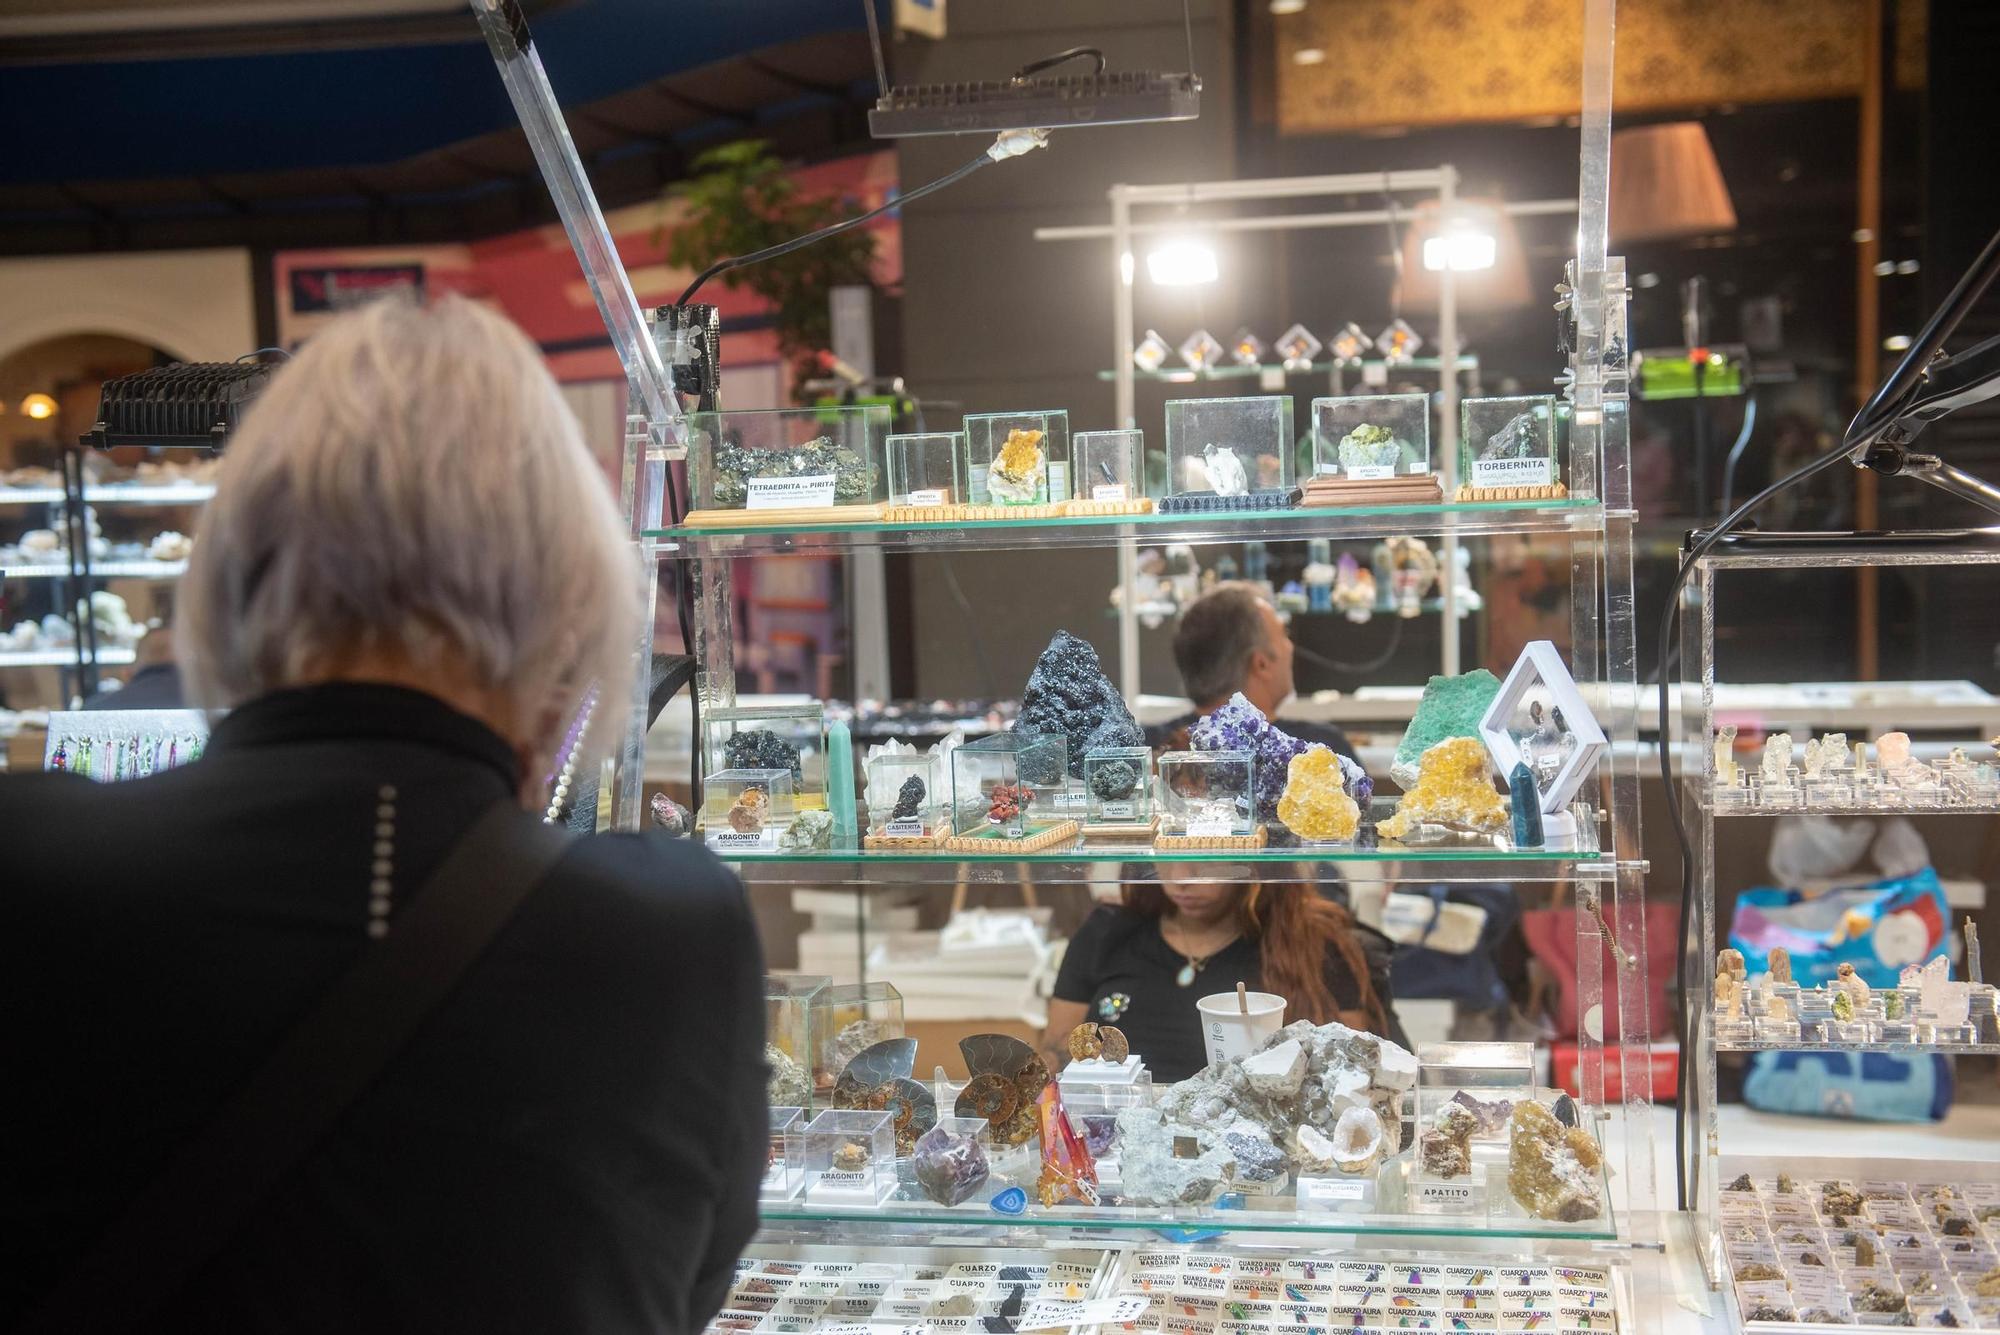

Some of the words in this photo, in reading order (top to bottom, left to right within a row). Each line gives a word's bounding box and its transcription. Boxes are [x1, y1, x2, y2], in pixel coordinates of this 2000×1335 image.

[1478, 460, 1545, 471] TORBERNITA
[749, 483, 801, 491] TETRAEDRITA
[810, 481, 835, 489] PIRITA
[718, 833, 760, 841] ARAGONITO
[821, 1173, 865, 1181] ARAGONITO
[1424, 1188, 1469, 1198] APATITO
[813, 1264, 854, 1272] FLUORITA
[958, 1264, 997, 1272] CUARZO
[1315, 1262, 1334, 1270] AURA
[1339, 1262, 1366, 1271] CUARZO
[1422, 1267, 1441, 1275] AURA
[1446, 1267, 1474, 1276] CUARZO
[1530, 1269, 1549, 1277] AURA
[1131, 1272, 1156, 1281] CUARZO
[1158, 1273, 1177, 1281] AURA
[1182, 1274, 1207, 1283] CUARZO
[1208, 1277, 1226, 1285] AURA
[1583, 1272, 1604, 1281] AURA
[858, 1282, 881, 1290] YESO
[1183, 1280, 1225, 1290] MANDARINA
[1260, 1280, 1279, 1288] AURA
[1315, 1284, 1333, 1292] AURA
[1338, 1285, 1366, 1293] CUARZO
[1392, 1286, 1420, 1295] CUARZO
[1421, 1288, 1441, 1296] AURA
[1475, 1289, 1495, 1297] AURA
[1503, 1290, 1531, 1299] CUARZO
[1531, 1290, 1552, 1299] AURA
[734, 1294, 780, 1305] ARAGONITO
[788, 1299, 828, 1307] FLUORITA
[846, 1299, 869, 1307] YESO
[1173, 1296, 1200, 1305] CUARZO
[1200, 1298, 1219, 1307] AURA
[1254, 1303, 1273, 1312] AURA
[1279, 1304, 1308, 1313] CUARZO
[1308, 1306, 1328, 1315] AURA
[1333, 1306, 1361, 1315] CUARZO
[1362, 1307, 1382, 1315] AURA
[718, 1313, 764, 1322] ARAGONITO
[1388, 1308, 1416, 1317] CUARZO
[1417, 1309, 1437, 1318] AURA
[1445, 1312, 1474, 1320] CUARZO
[1474, 1312, 1495, 1321] AURA
[1502, 1312, 1531, 1320] CUARZO
[1560, 1309, 1589, 1318] CUARZO
[1588, 1312, 1610, 1321] AURA
[773, 1315, 814, 1325] FLUORITA
[1167, 1317, 1193, 1326] CUARZO
[1194, 1320, 1215, 1329] AURA
[1221, 1322, 1249, 1331] CUARZO
[1250, 1324, 1270, 1332] AURA
[1277, 1325, 1306, 1333] CUARZO
